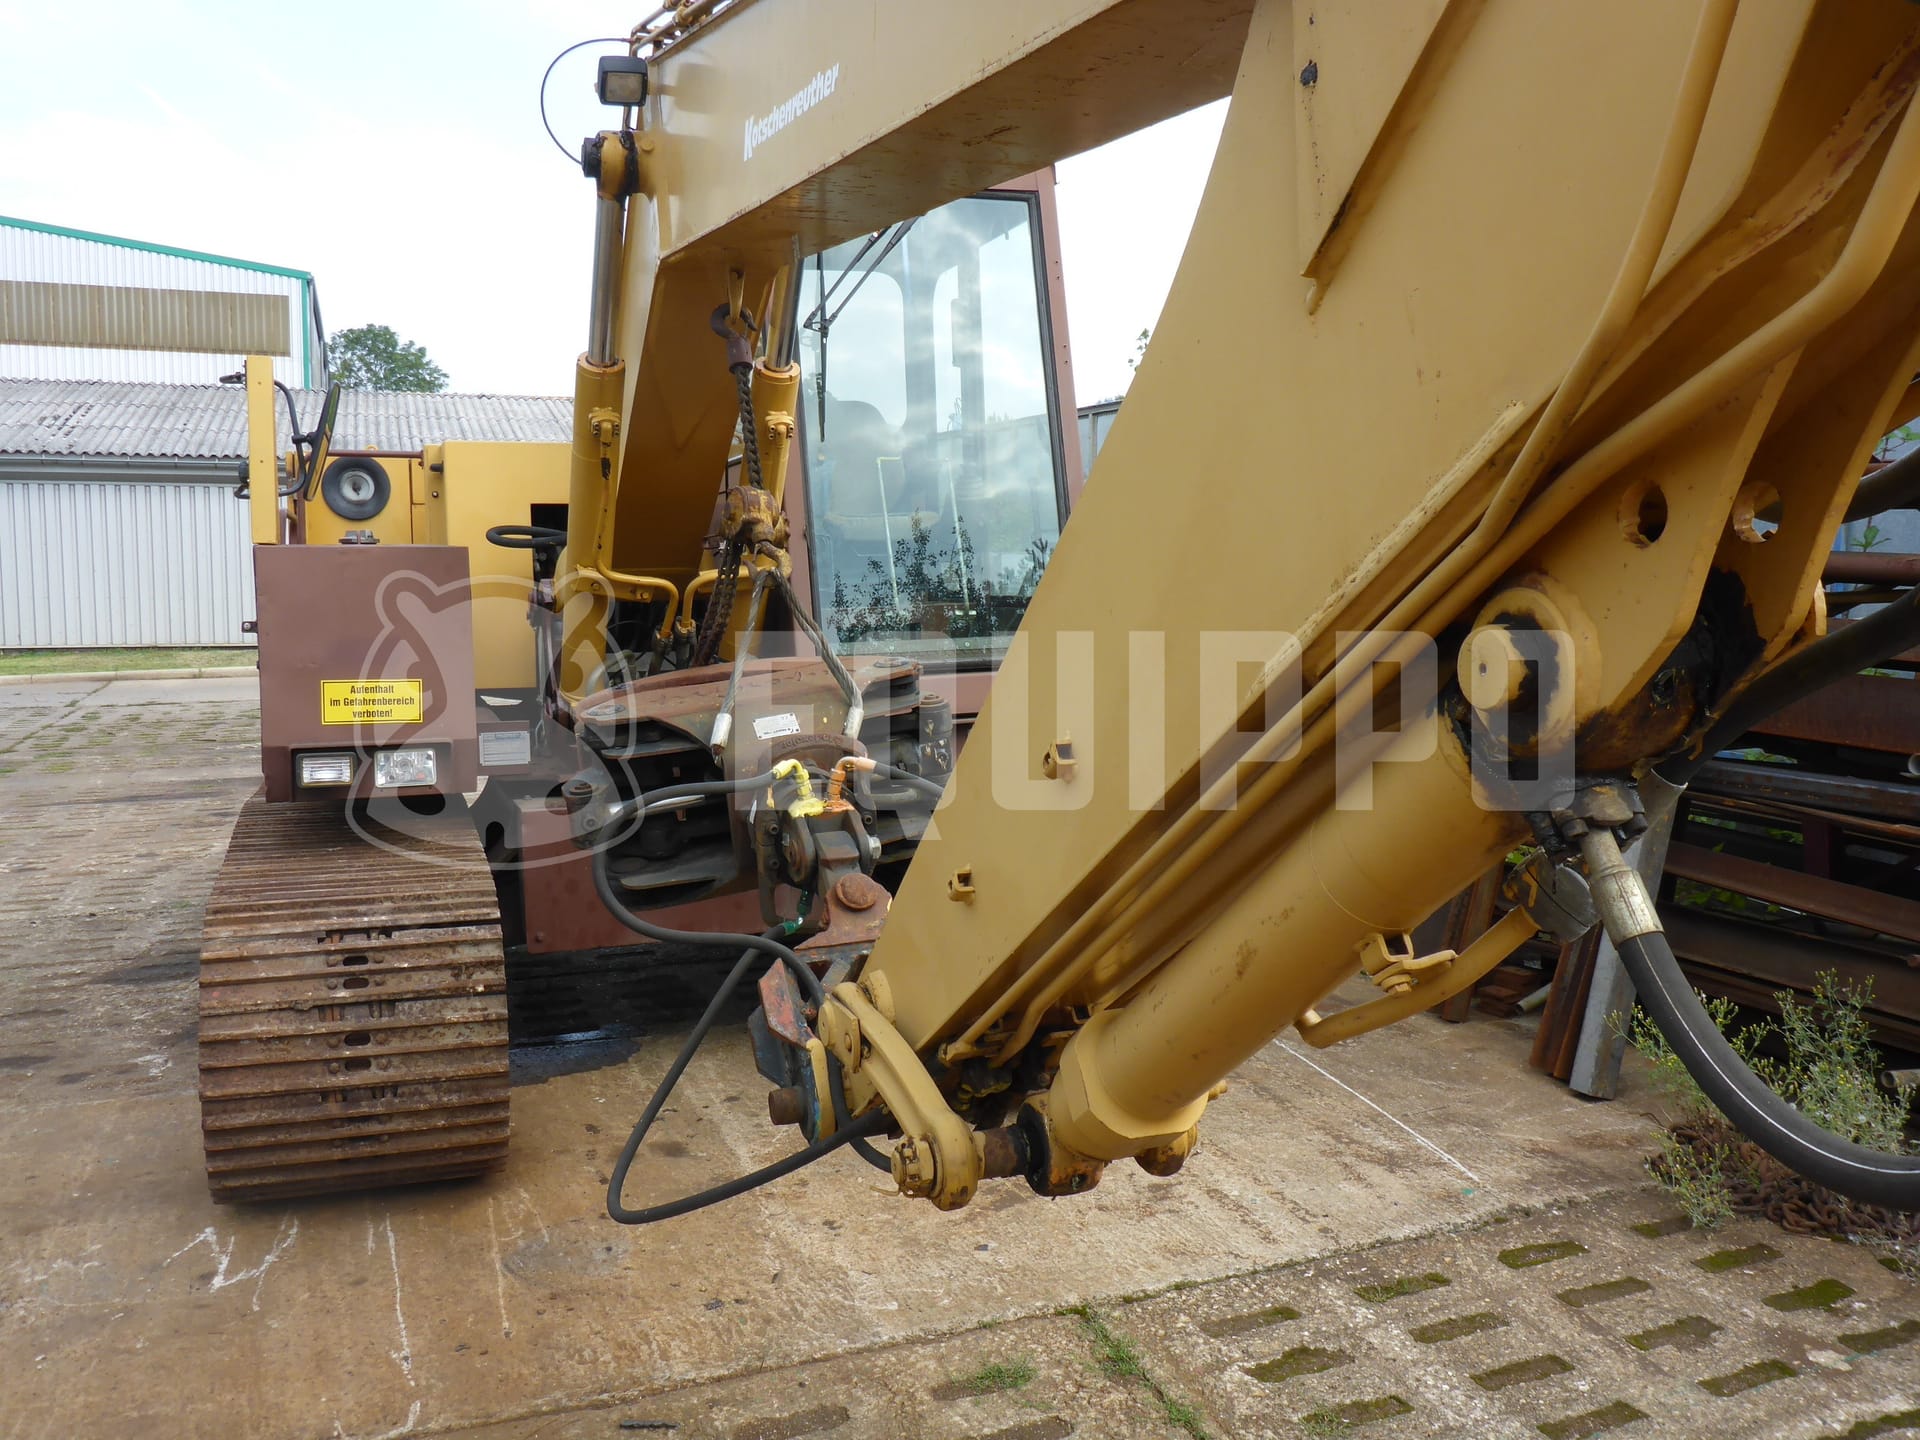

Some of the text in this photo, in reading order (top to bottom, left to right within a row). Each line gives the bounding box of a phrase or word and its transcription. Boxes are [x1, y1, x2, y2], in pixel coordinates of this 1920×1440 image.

[743, 62, 840, 162] Kotschenreuther
[350, 685, 394, 694] Aufenthalt
[329, 697, 415, 707] im Gefahrenbereich
[352, 709, 393, 718] verboten!
